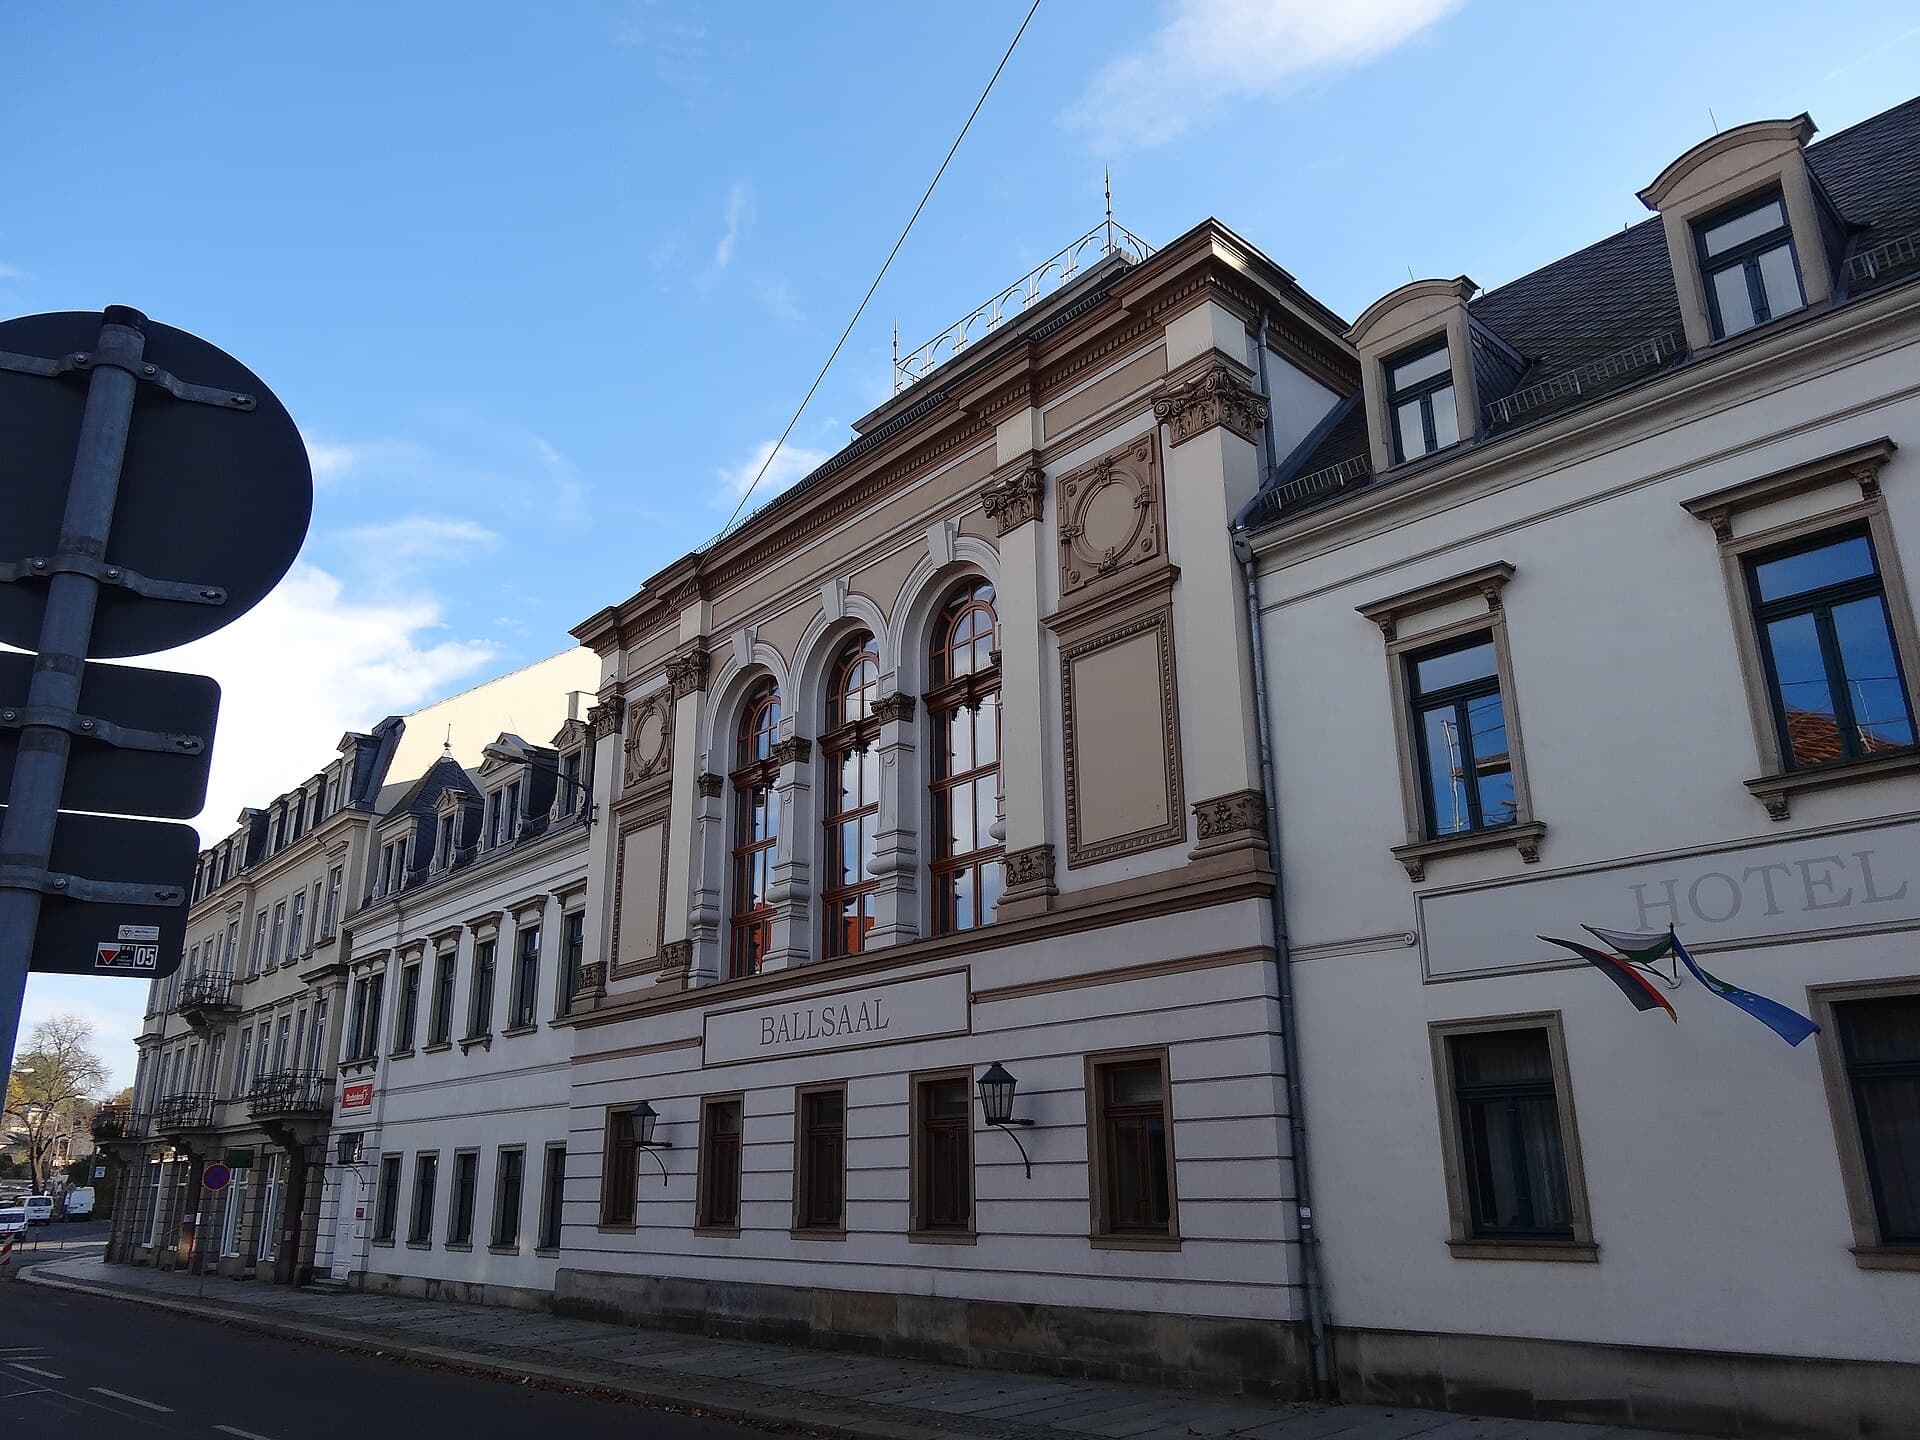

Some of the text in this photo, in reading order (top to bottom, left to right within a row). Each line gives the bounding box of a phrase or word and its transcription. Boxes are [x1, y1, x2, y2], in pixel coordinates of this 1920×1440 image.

[1628, 850, 1909, 932] HOTEL
[136, 947, 156, 966] 05
[759, 998, 890, 1046] BALLSAAL
